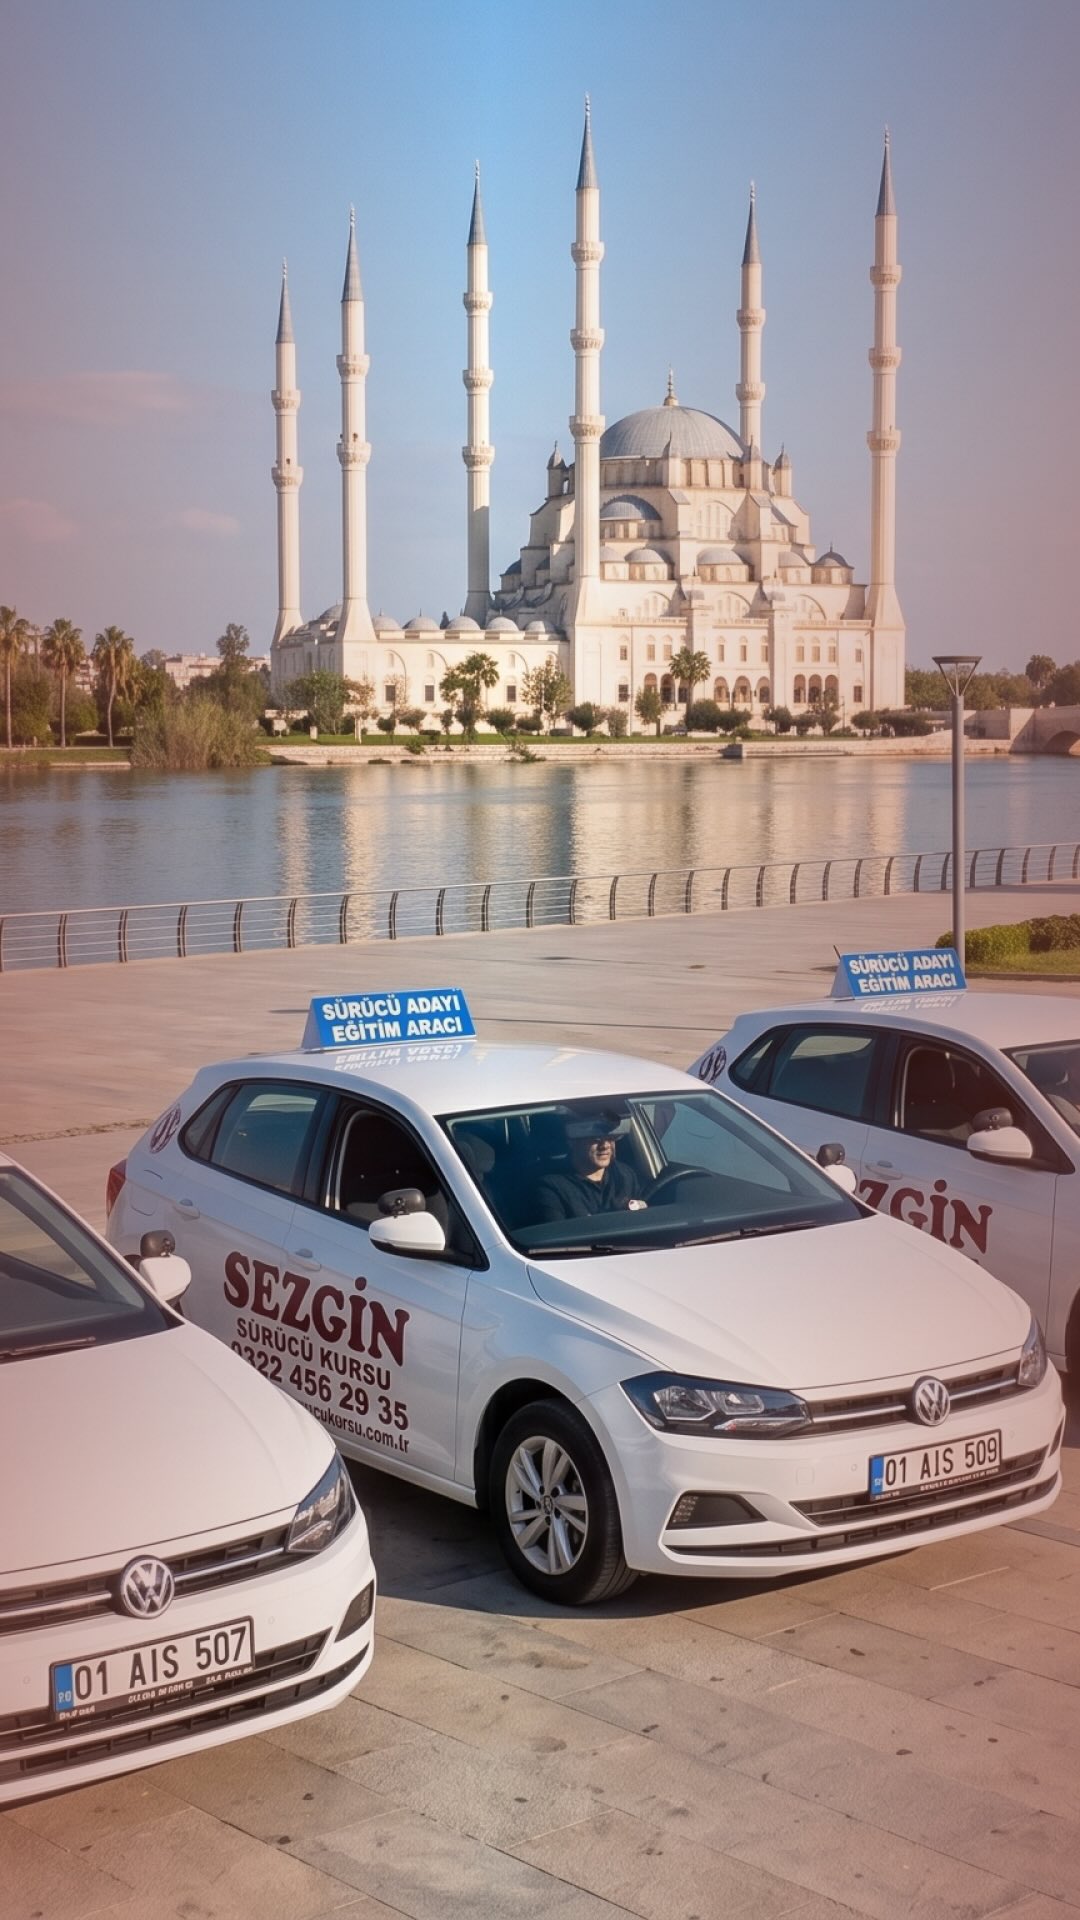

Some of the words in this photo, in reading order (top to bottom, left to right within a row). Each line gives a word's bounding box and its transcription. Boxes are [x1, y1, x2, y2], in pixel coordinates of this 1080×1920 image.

[849, 952, 909, 975] SÜRÜCÜ
[913, 954, 955, 971] ADAYI
[914, 973, 957, 989] ARACI
[322, 994, 400, 1021] SÜRÜCÜ
[407, 995, 461, 1015] ADAYI
[332, 1018, 402, 1042] EĞİTİM
[407, 1016, 463, 1036] ARACI
[224, 1251, 410, 1367] SEZGİN
[237, 1317, 313, 1362] SÜRÜCÜ
[320, 1347, 391, 1391] KURSU
[289, 1363, 332, 1402] 456
[339, 1382, 369, 1416] 29
[378, 1395, 409, 1431] 35
[885, 1456, 907, 1486] 01
[920, 1447, 954, 1481] AIS
[965, 1437, 997, 1469] 509
[75, 1660, 108, 1700] 01
[129, 1645, 179, 1689] AIS
[195, 1626, 246, 1670] 507
